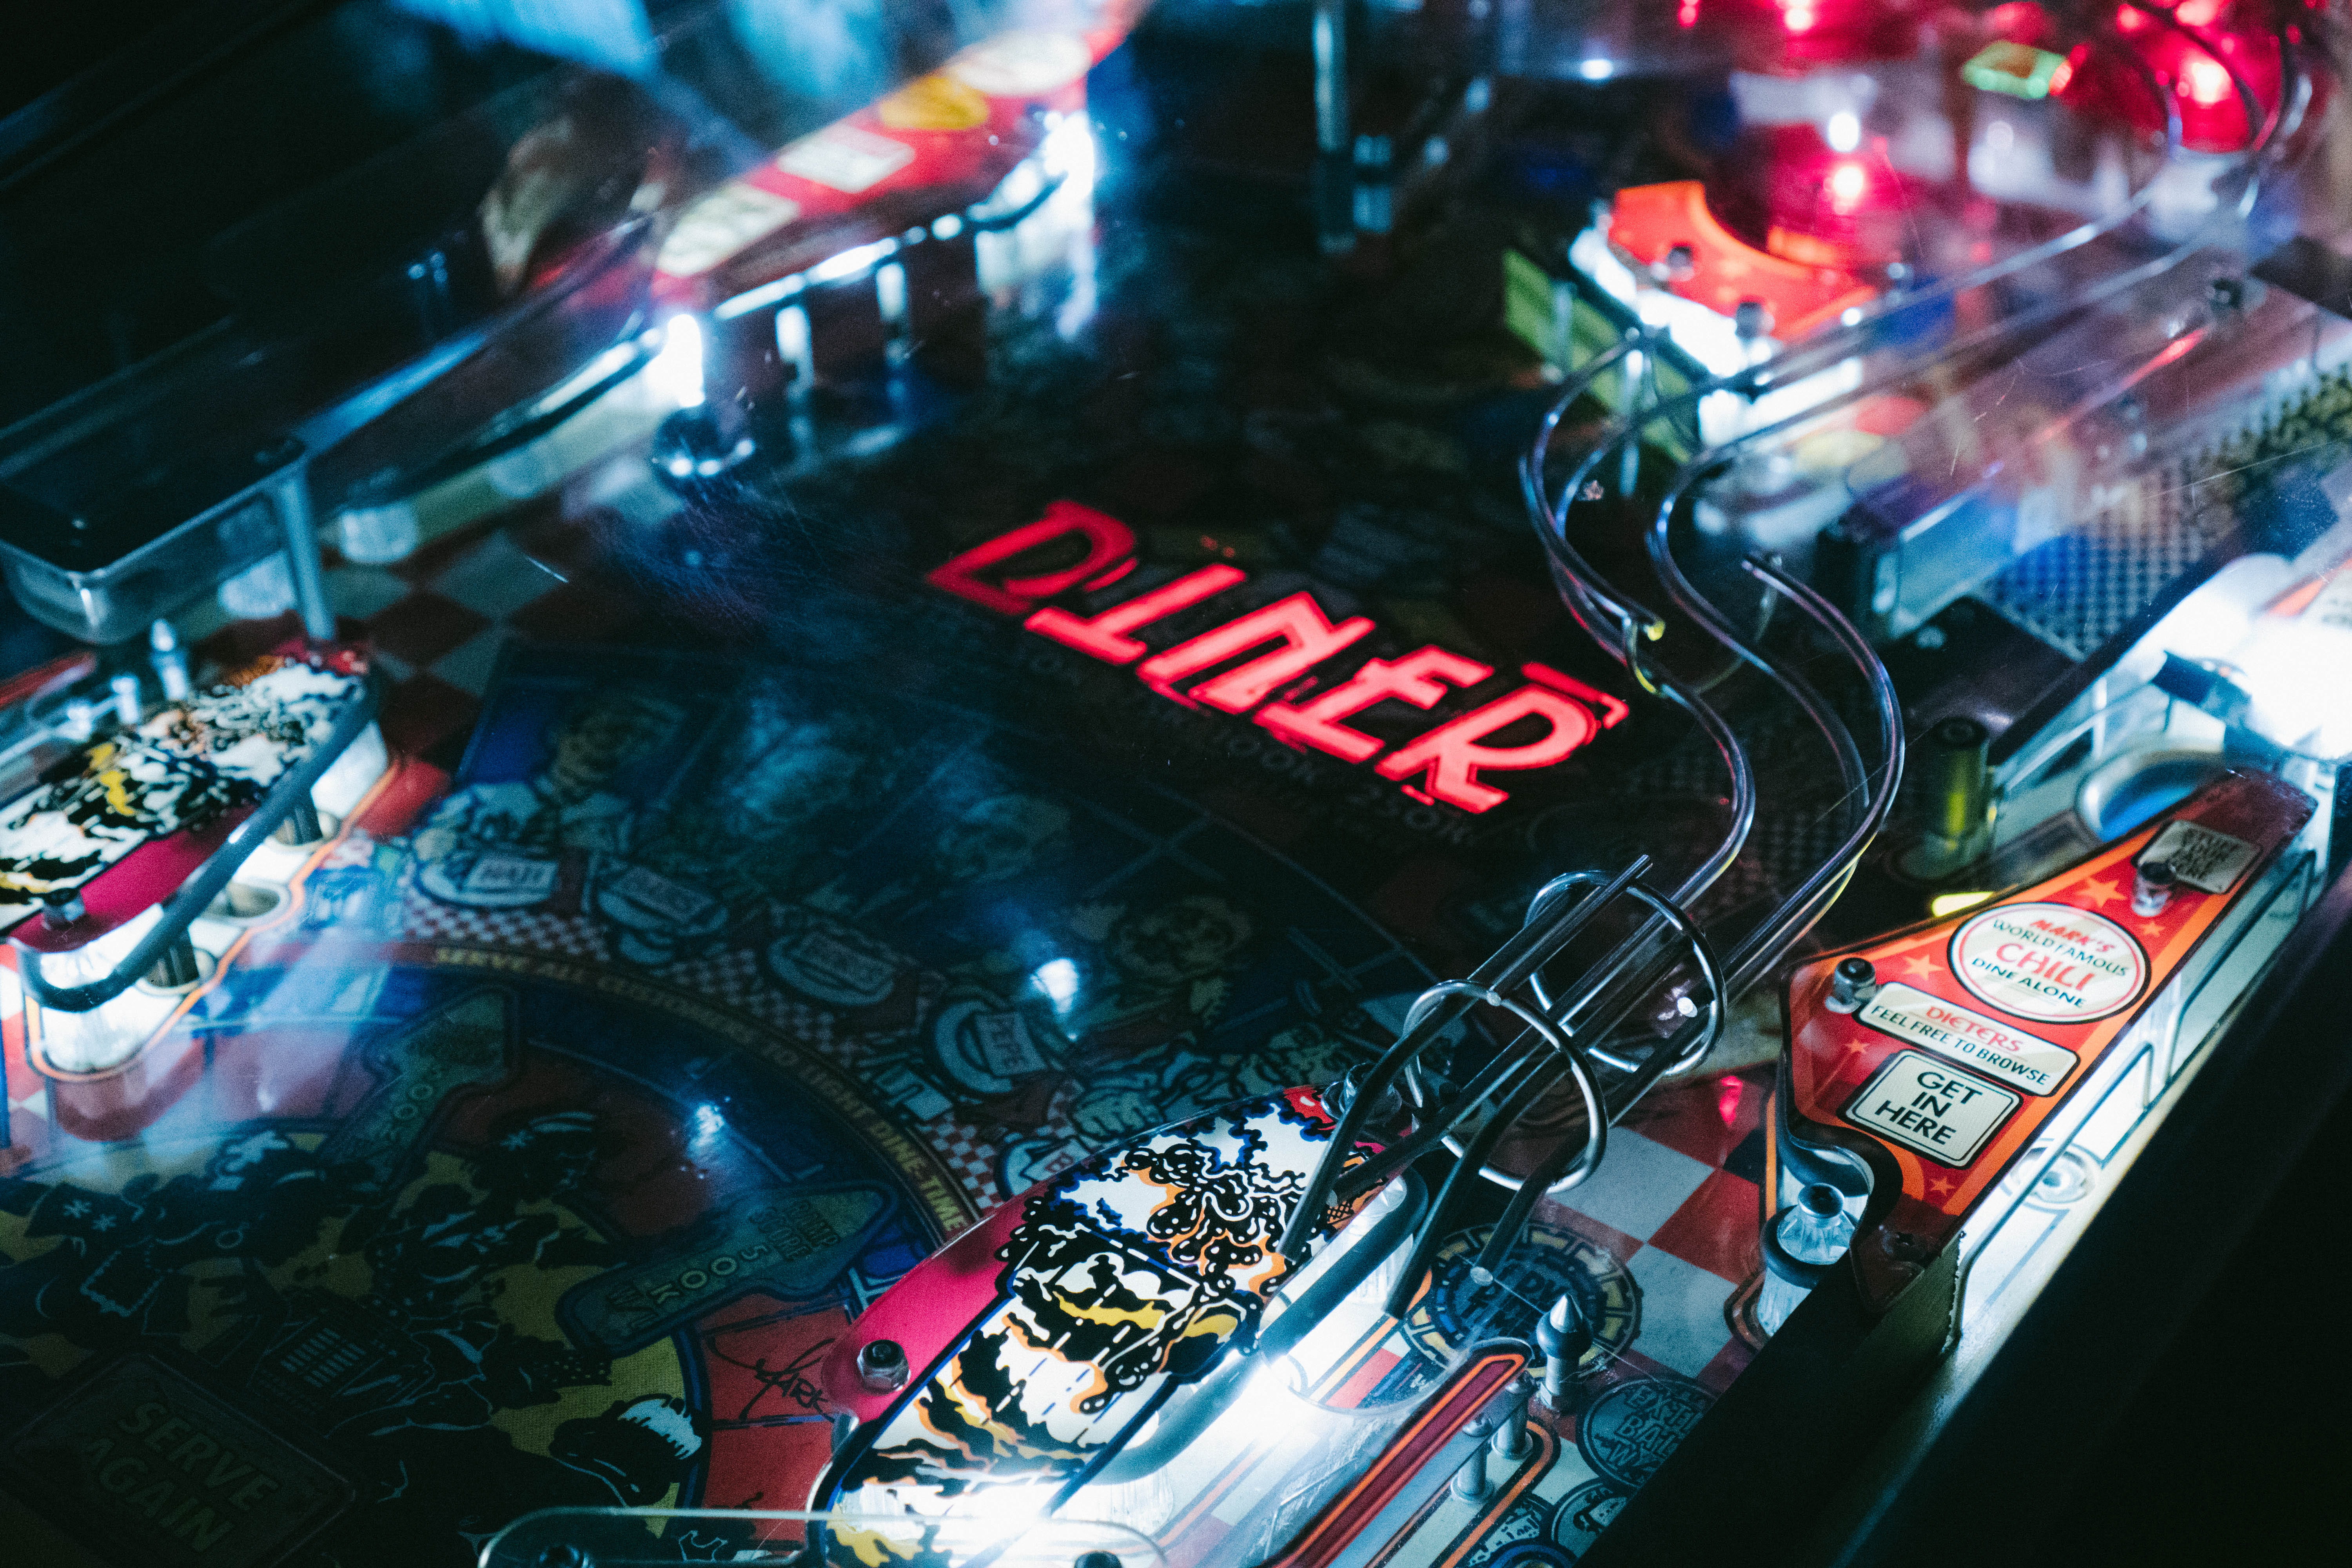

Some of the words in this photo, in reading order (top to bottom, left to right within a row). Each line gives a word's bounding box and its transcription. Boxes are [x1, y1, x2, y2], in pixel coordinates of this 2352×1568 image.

[926, 499, 1627, 813] DINER
[1993, 919, 2054, 948] WORLD
[2054, 943, 2129, 977] FAMOUS
[2029, 919, 2115, 952] MARK'S
[1971, 957, 2017, 980] DINE
[2018, 976, 2087, 1009] ALONE
[1996, 943, 2095, 991] CHILI
[1871, 1005, 1907, 1028] FEEL
[1911, 1020, 1953, 1045] FREE
[1953, 1038, 1976, 1054] TO
[1978, 1047, 2051, 1086] BROWSE
[1926, 1005, 2025, 1053] DIETERS
[1911, 1091, 1953, 1118] IN
[1916, 1071, 1983, 1105] GET
[797, 1063, 879, 1120] LIGHT
[867, 1119, 970, 1232] DINE-TIME
[1874, 1100, 1957, 1145] HERE
[117, 1401, 280, 1512] SERVE
[1615, 1415, 1679, 1459] BAL
[83, 1437, 235, 1553] AGAIN
